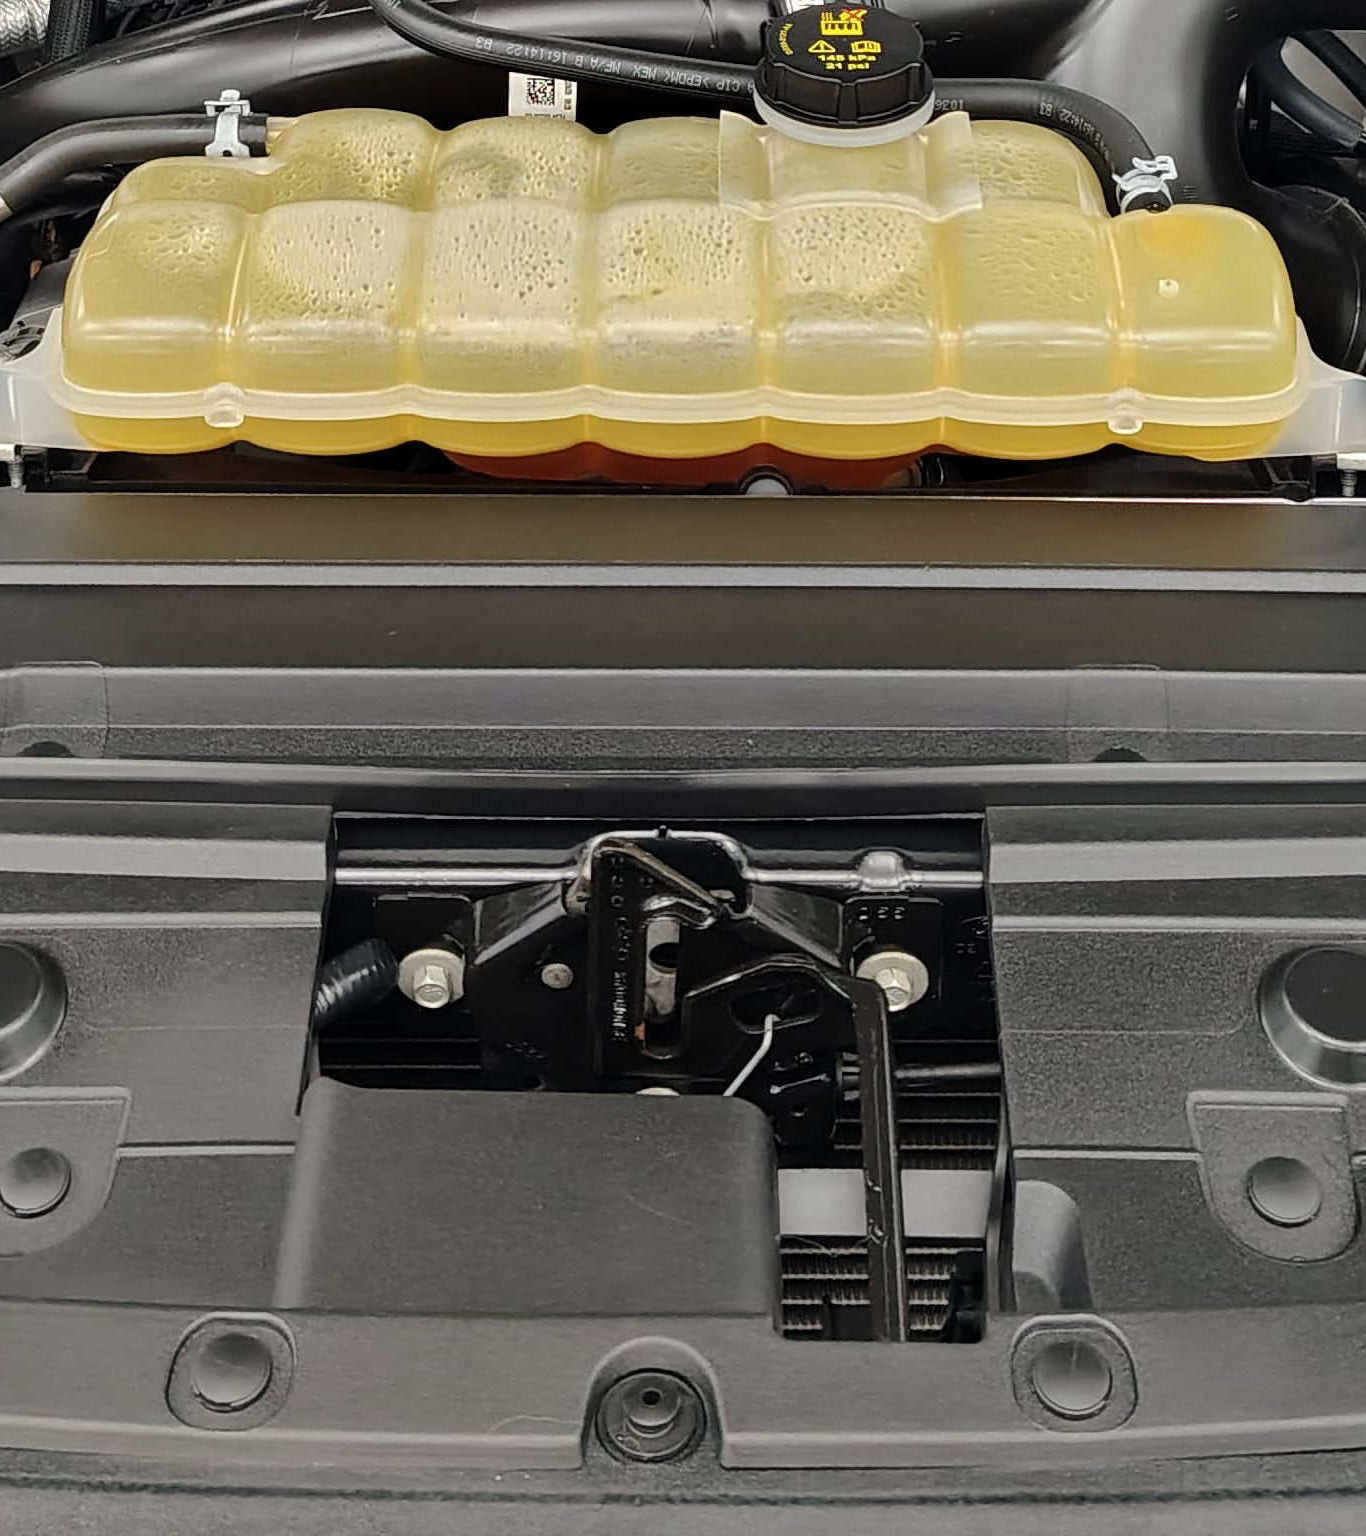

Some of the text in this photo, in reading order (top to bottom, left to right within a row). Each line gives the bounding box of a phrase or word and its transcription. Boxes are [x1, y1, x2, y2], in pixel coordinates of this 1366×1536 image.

[474, 36, 494, 52] B3
[817, 54, 877, 62] 145 kPa
[632, 64, 658, 80] MEX
[825, 62, 870, 71] 21 psi
[716, 77, 741, 93] CIP
